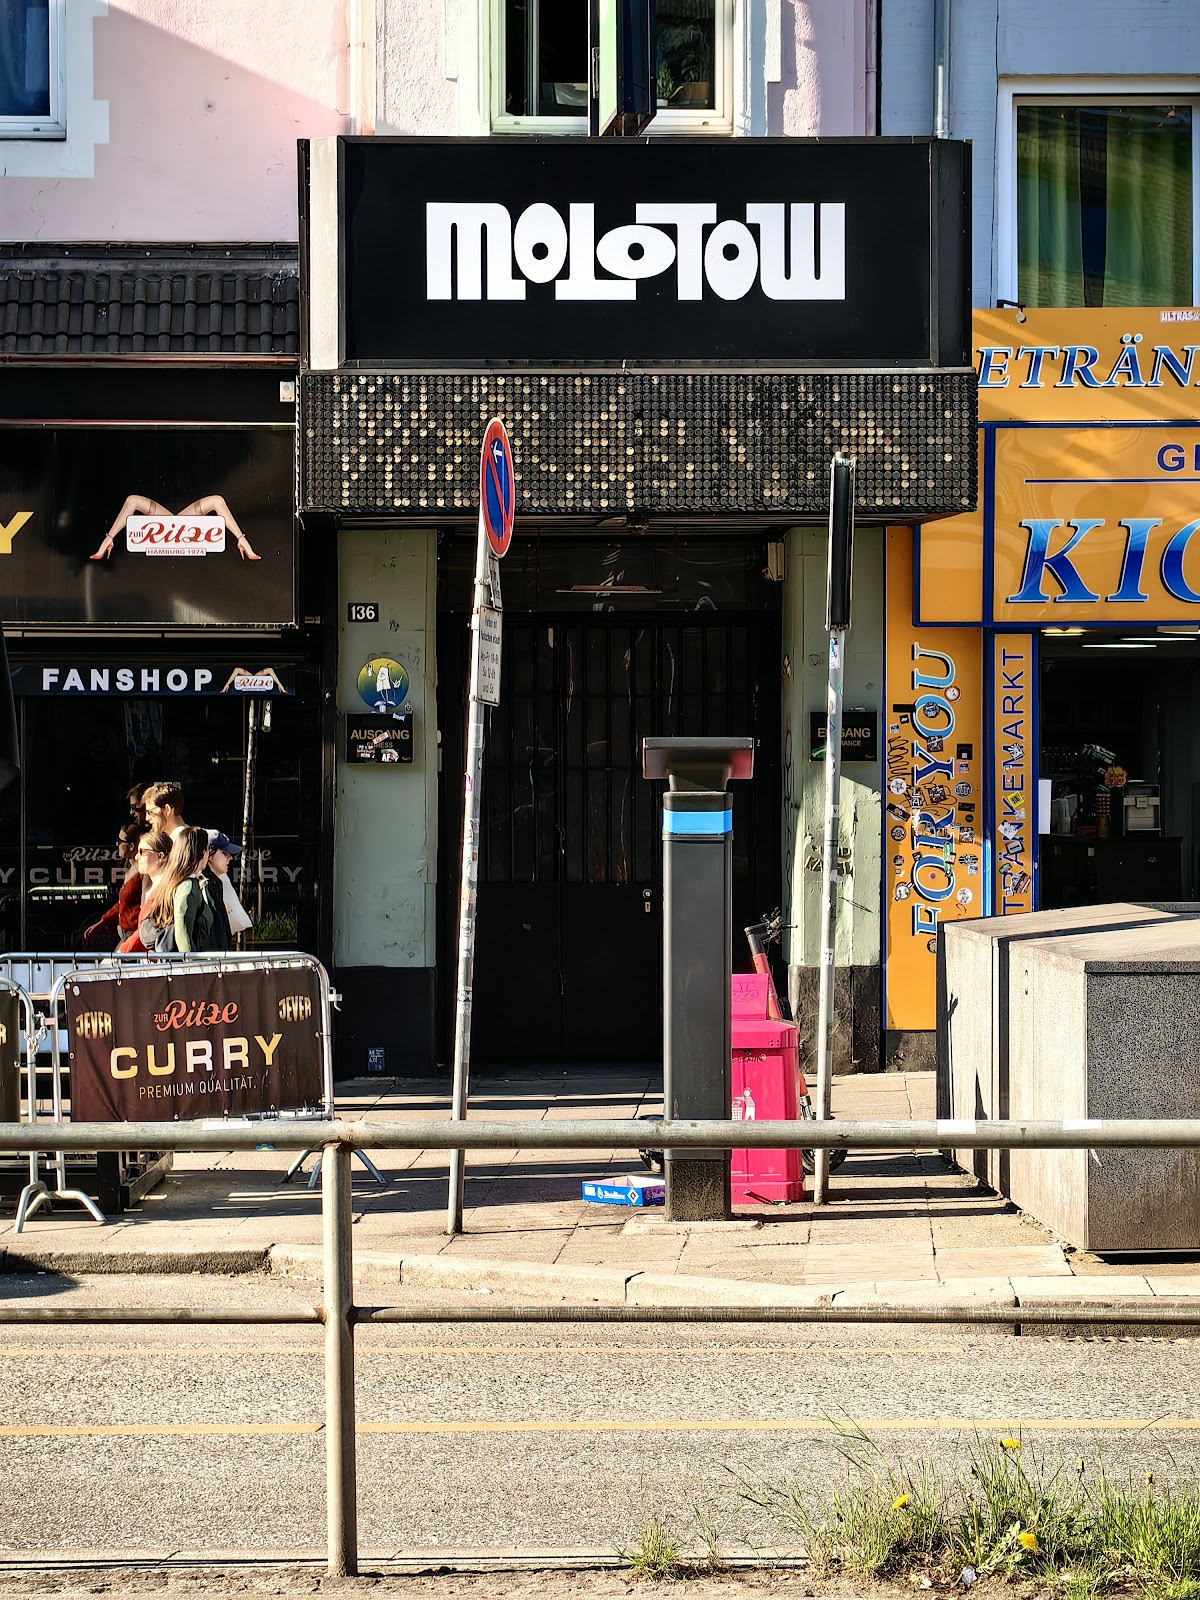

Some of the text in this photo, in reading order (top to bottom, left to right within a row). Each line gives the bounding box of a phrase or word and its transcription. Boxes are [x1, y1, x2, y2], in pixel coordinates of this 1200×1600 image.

[426, 202, 846, 301] MOLOTOW
[977, 333, 1200, 388] ETRÄN
[1156, 443, 1200, 473] G
[130, 522, 223, 544] Ritze
[351, 605, 376, 620] 136
[42, 668, 213, 691] FANSHOP
[911, 642, 956, 785] YOU
[153, 999, 239, 1031] ZUR Ritze
[278, 995, 312, 1023] JEVER
[75, 1011, 113, 1039] JEVER
[110, 1033, 283, 1079] CURRY
[139, 1081, 195, 1100] PREMIUM
